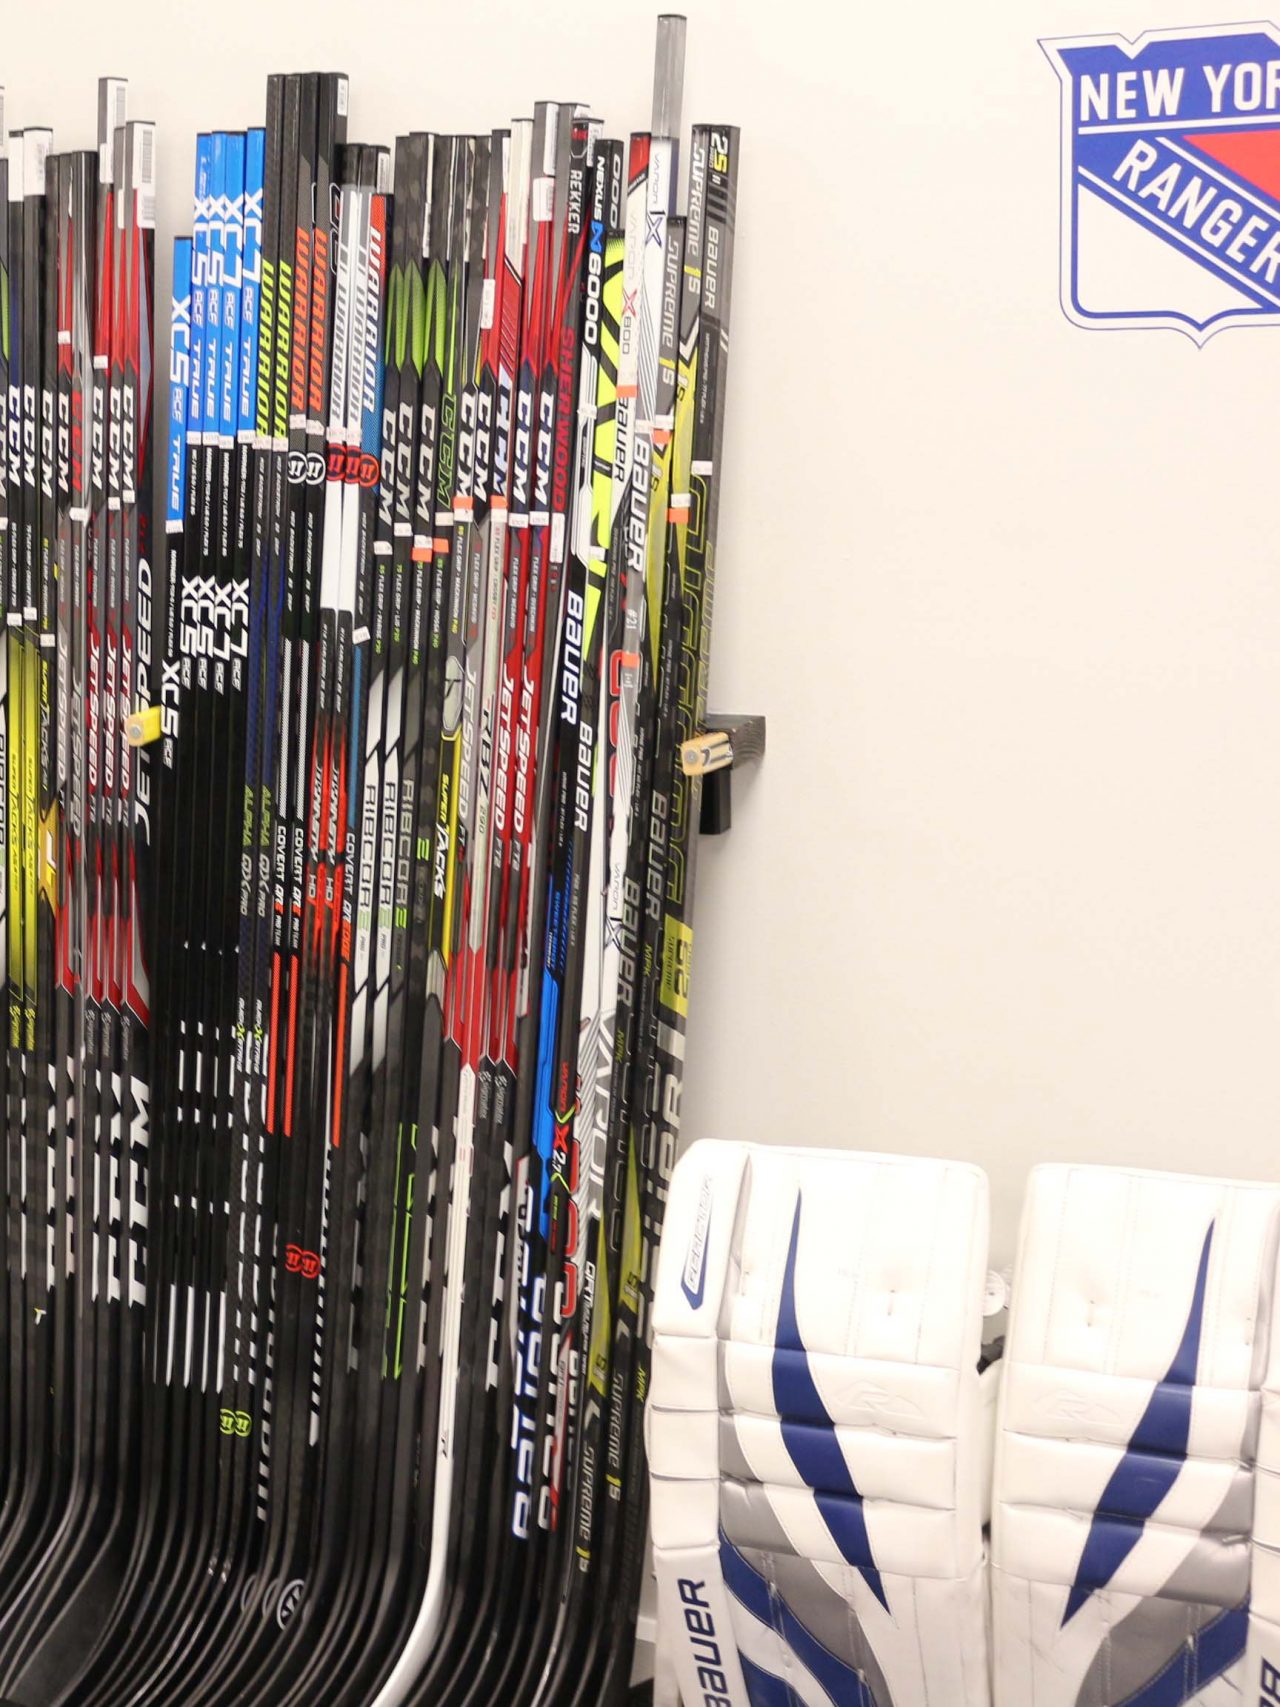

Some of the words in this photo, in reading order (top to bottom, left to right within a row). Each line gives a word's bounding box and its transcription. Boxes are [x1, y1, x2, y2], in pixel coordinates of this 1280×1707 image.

[1080, 67, 1185, 121] NEW
[192, 194, 209, 286] XC5
[243, 188, 262, 284] XC7
[568, 170, 581, 234] REKKER
[593, 156, 606, 220] NEXUS
[687, 144, 706, 255] SUPREME
[206, 194, 223, 288] XC5
[223, 193, 243, 289] XC7
[662, 236, 680, 348] SUPREME
[704, 225, 719, 309] BAUER
[170, 294, 190, 387] XC5
[256, 258, 273, 437] WARRIOR
[274, 260, 291, 439] WARRIOR
[292, 226, 309, 410] WARRIOR
[309, 227, 328, 412] WARRIOR
[364, 226, 381, 414] WARRIOR
[191, 339, 200, 419] TRUE
[206, 338, 216, 419] TRUE
[223, 341, 233, 423] TRUE
[241, 336, 251, 418] TRUE
[24, 384, 36, 488] CCM
[41, 389, 53, 499] CCM
[92, 386, 103, 489] CCM
[108, 387, 120, 491] CCM
[123, 384, 135, 490] CCM
[171, 435, 181, 511] TRUE
[379, 408, 396, 527] CCM
[395, 401, 413, 522] CCM
[416, 403, 436, 522] CCM
[437, 394, 456, 510] CCM
[456, 392, 474, 498] CCM
[474, 392, 491, 503] CCM
[513, 389, 532, 503] CCM
[535, 390, 553, 505] CCM
[627, 437, 649, 572] BAUER
[180, 575, 199, 658] XC5
[197, 575, 215, 659] XC5
[214, 582, 231, 661] XC7
[230, 578, 249, 658] XC7
[561, 590, 583, 725] BAUER
[626, 608, 637, 630] #21
[89, 631, 100, 786] JETSPEED
[106, 633, 118, 790] JETSPEED
[161, 659, 179, 738] XC5
[458, 656, 476, 819] JETSPEED
[495, 664, 514, 830] JETSPEED
[513, 666, 534, 833] JETSPEED
[243, 785, 253, 846] ALPHA
[260, 785, 271, 846] ALPHA
[574, 720, 593, 832] BAUER
[276, 825, 286, 882] COVERT
[293, 828, 304, 884] COVERT
[344, 833, 355, 895] COVERT
[645, 789, 667, 921] BAUER
[618, 877, 640, 1007] BAUER
[129, 1075, 149, 1308] CCM
[607, 1373, 624, 1468] SUPREME
[579, 1447, 595, 1540] SUPREME
[677, 1578, 732, 1707] BAUER
